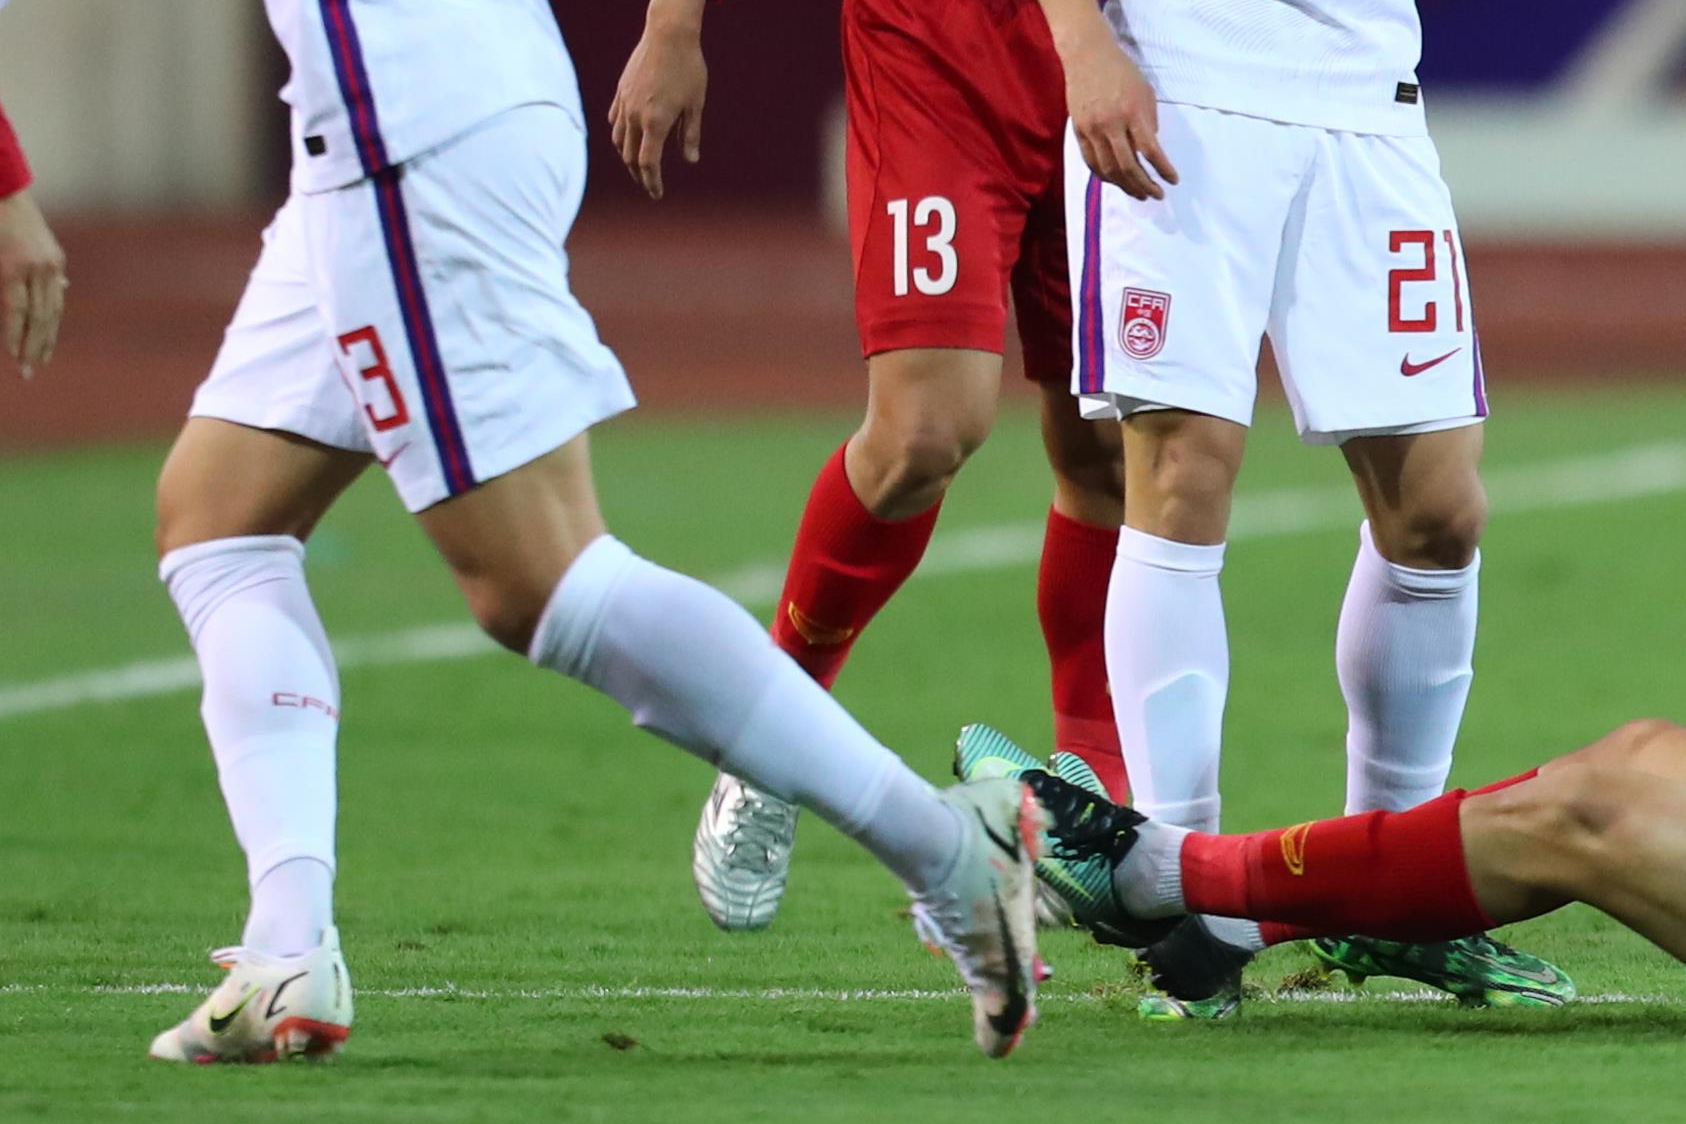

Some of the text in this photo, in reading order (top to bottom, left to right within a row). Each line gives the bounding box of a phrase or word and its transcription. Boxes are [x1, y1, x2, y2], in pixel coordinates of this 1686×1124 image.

[887, 195, 958, 296] 13
[1388, 229, 1464, 333] 21
[1127, 293, 1165, 311] CFA
[333, 324, 411, 432] 3
